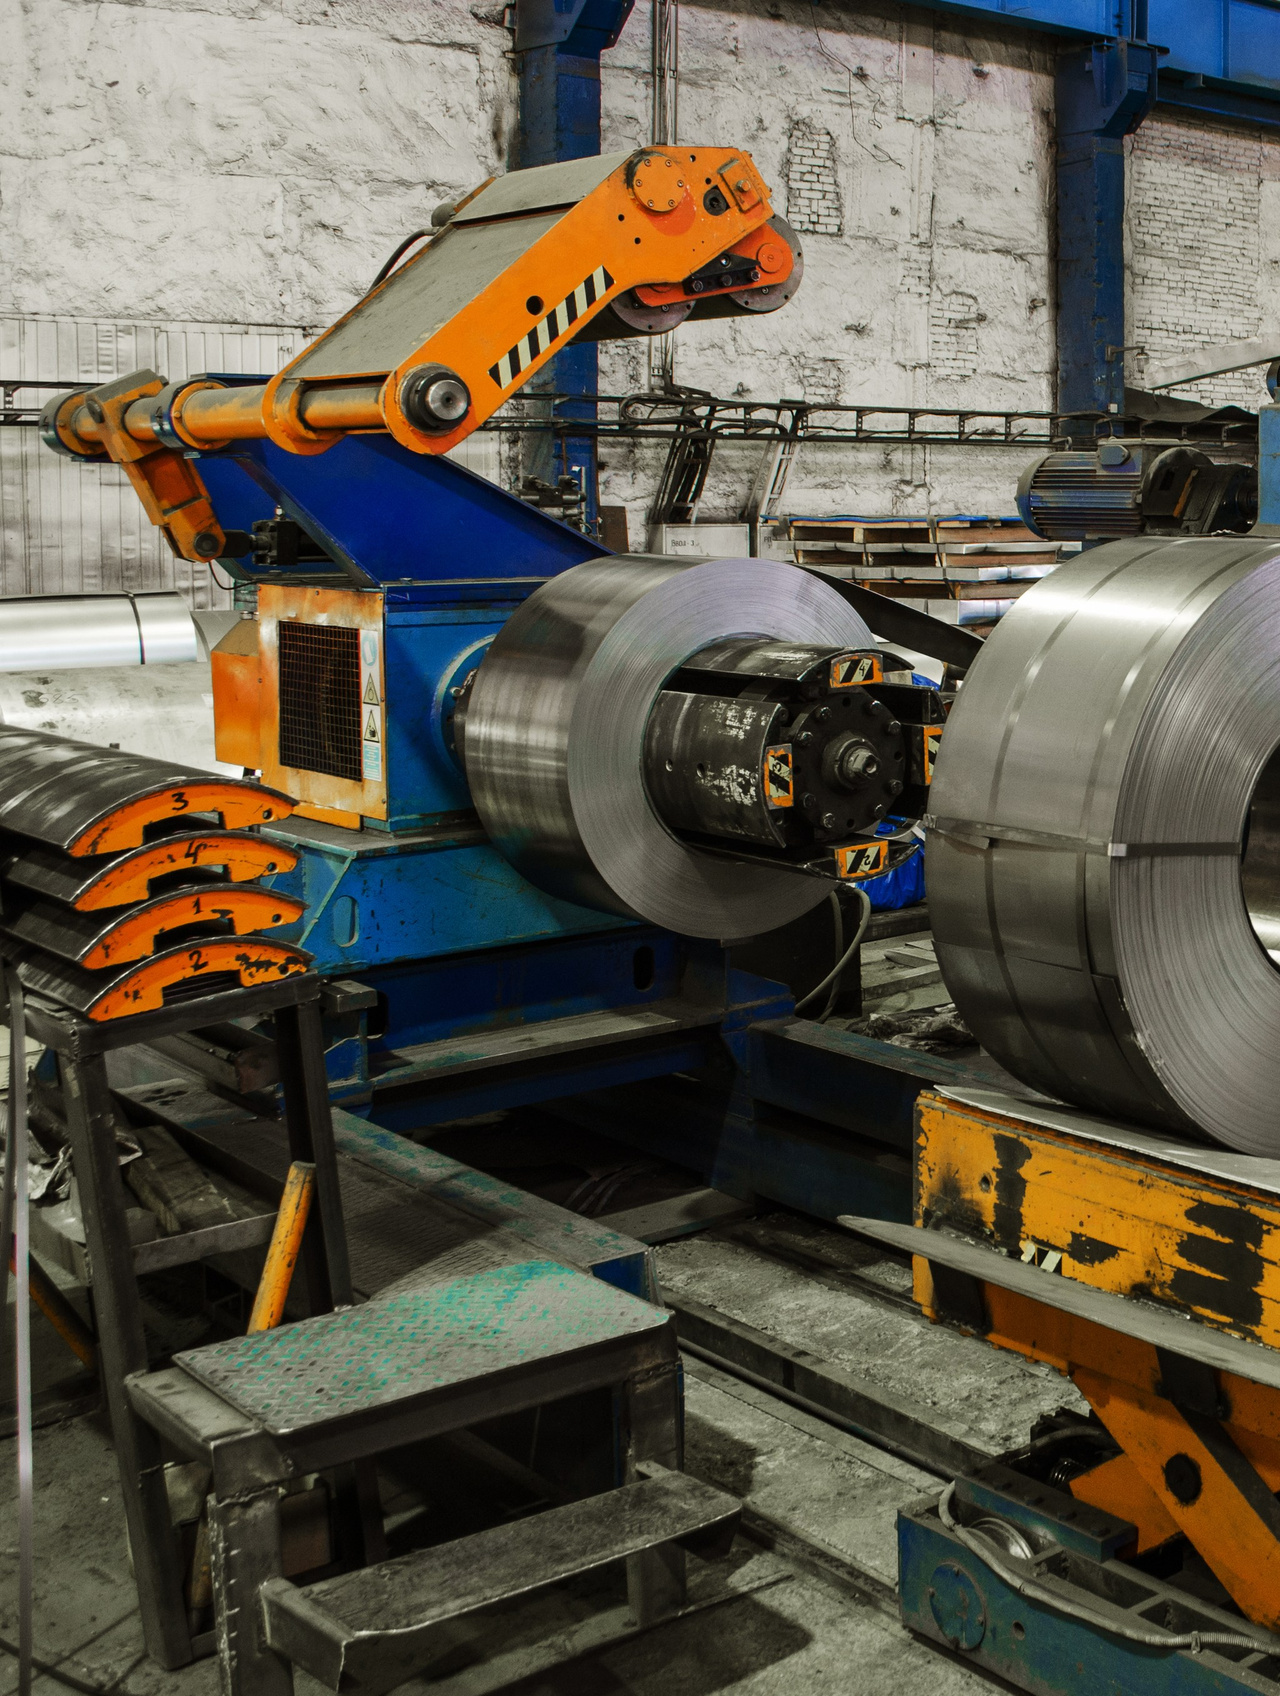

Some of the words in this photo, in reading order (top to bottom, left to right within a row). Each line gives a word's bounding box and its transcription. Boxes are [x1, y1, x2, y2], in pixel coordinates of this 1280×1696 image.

[171, 791, 189, 811] 3
[184, 840, 200, 864] 4
[192, 896, 203, 915] 1
[188, 949, 209, 972] 2
